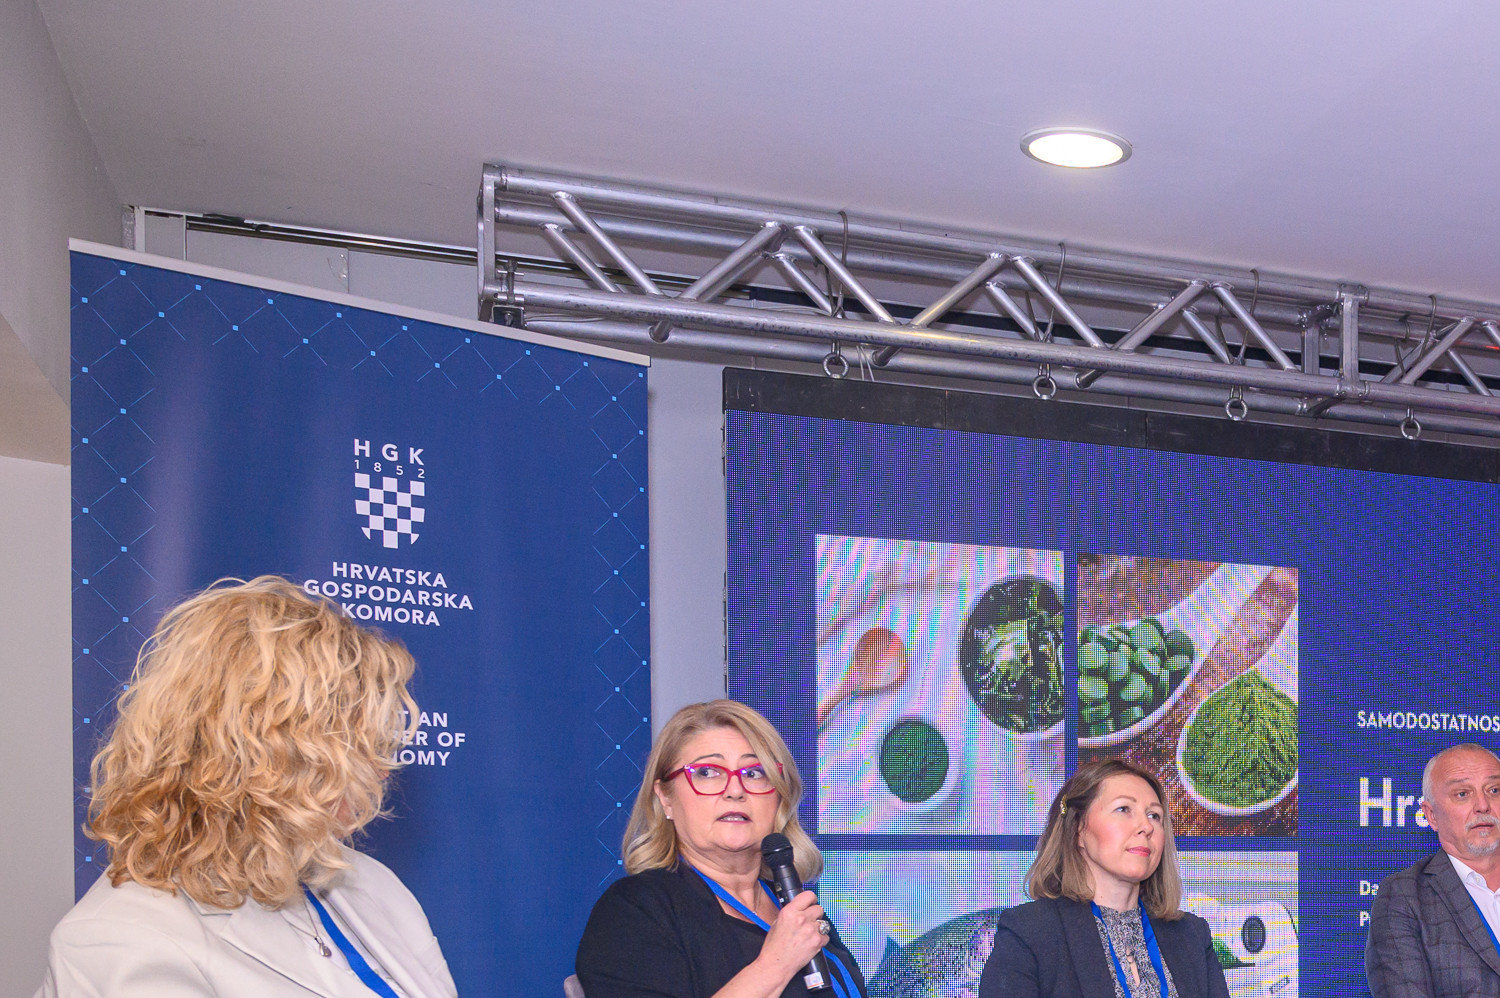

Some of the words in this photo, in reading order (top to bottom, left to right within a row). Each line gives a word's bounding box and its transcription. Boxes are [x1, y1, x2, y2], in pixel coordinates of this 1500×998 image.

[332, 561, 447, 588] HRVATSKA
[303, 578, 473, 610] GOSPODARSKA
[341, 602, 440, 626] KOMORA
[437, 731, 466, 748] OF
